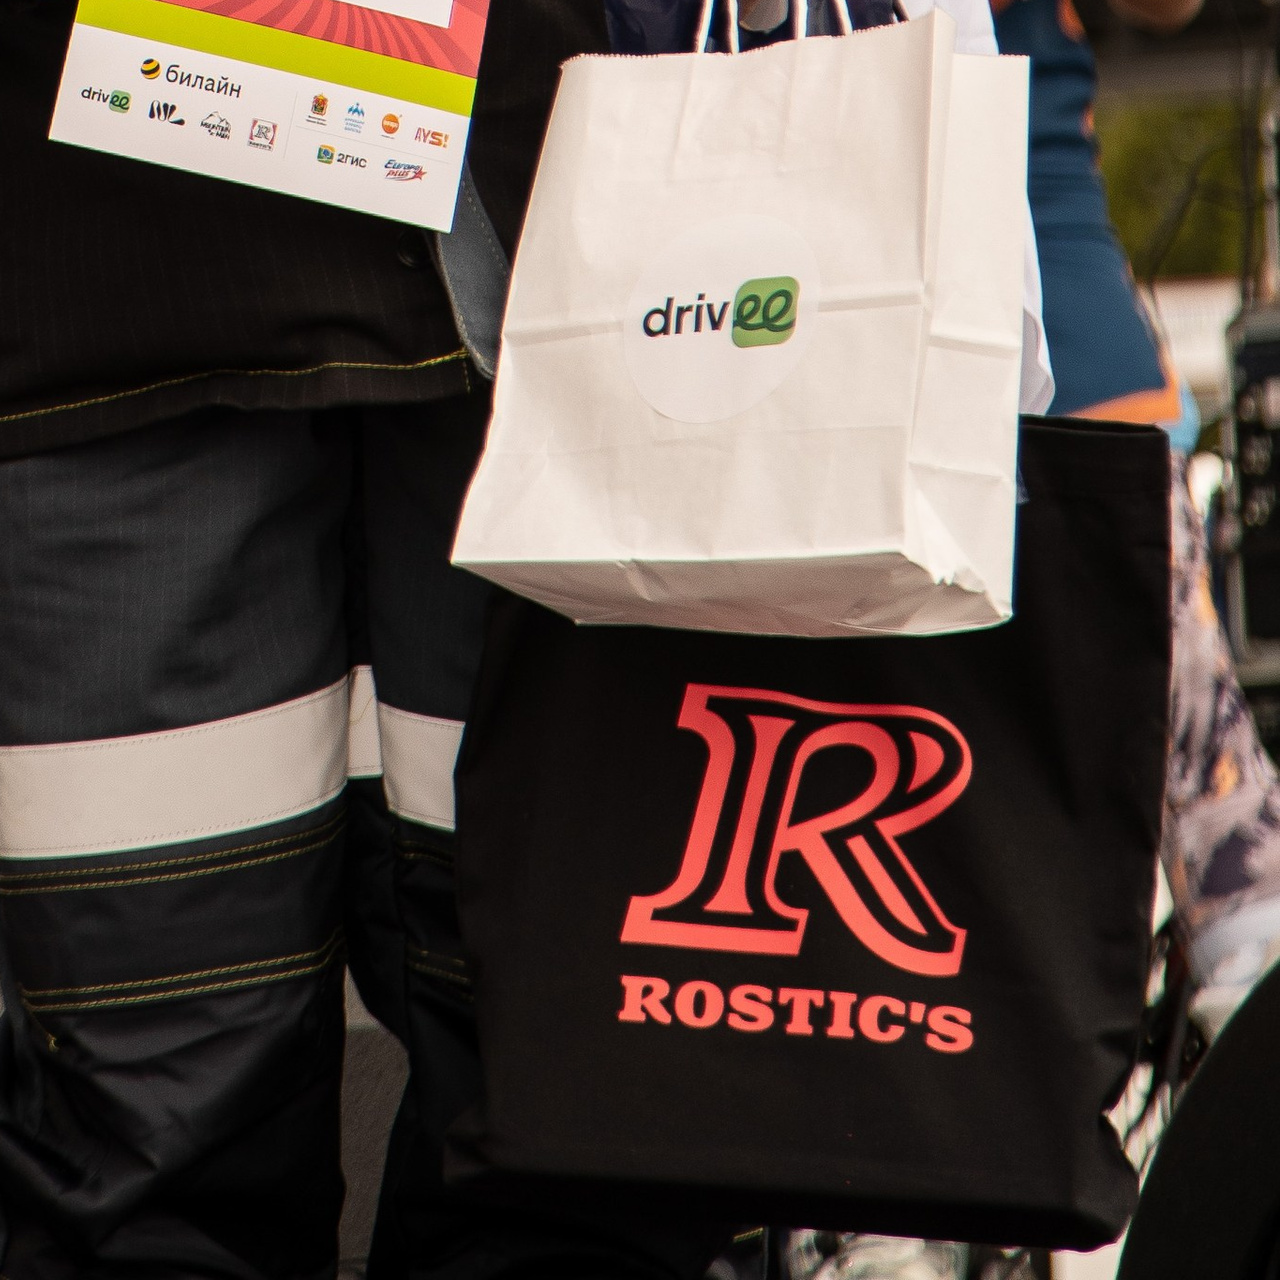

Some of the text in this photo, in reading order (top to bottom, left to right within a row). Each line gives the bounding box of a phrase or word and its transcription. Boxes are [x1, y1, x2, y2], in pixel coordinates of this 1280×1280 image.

[81, 86, 131, 111] drivee
[165, 64, 242, 99] билайн
[336, 153, 368, 169] 2ГИС
[642, 288, 796, 338] drivee
[620, 682, 973, 978] R
[617, 974, 974, 1053] ROSTIC'S
